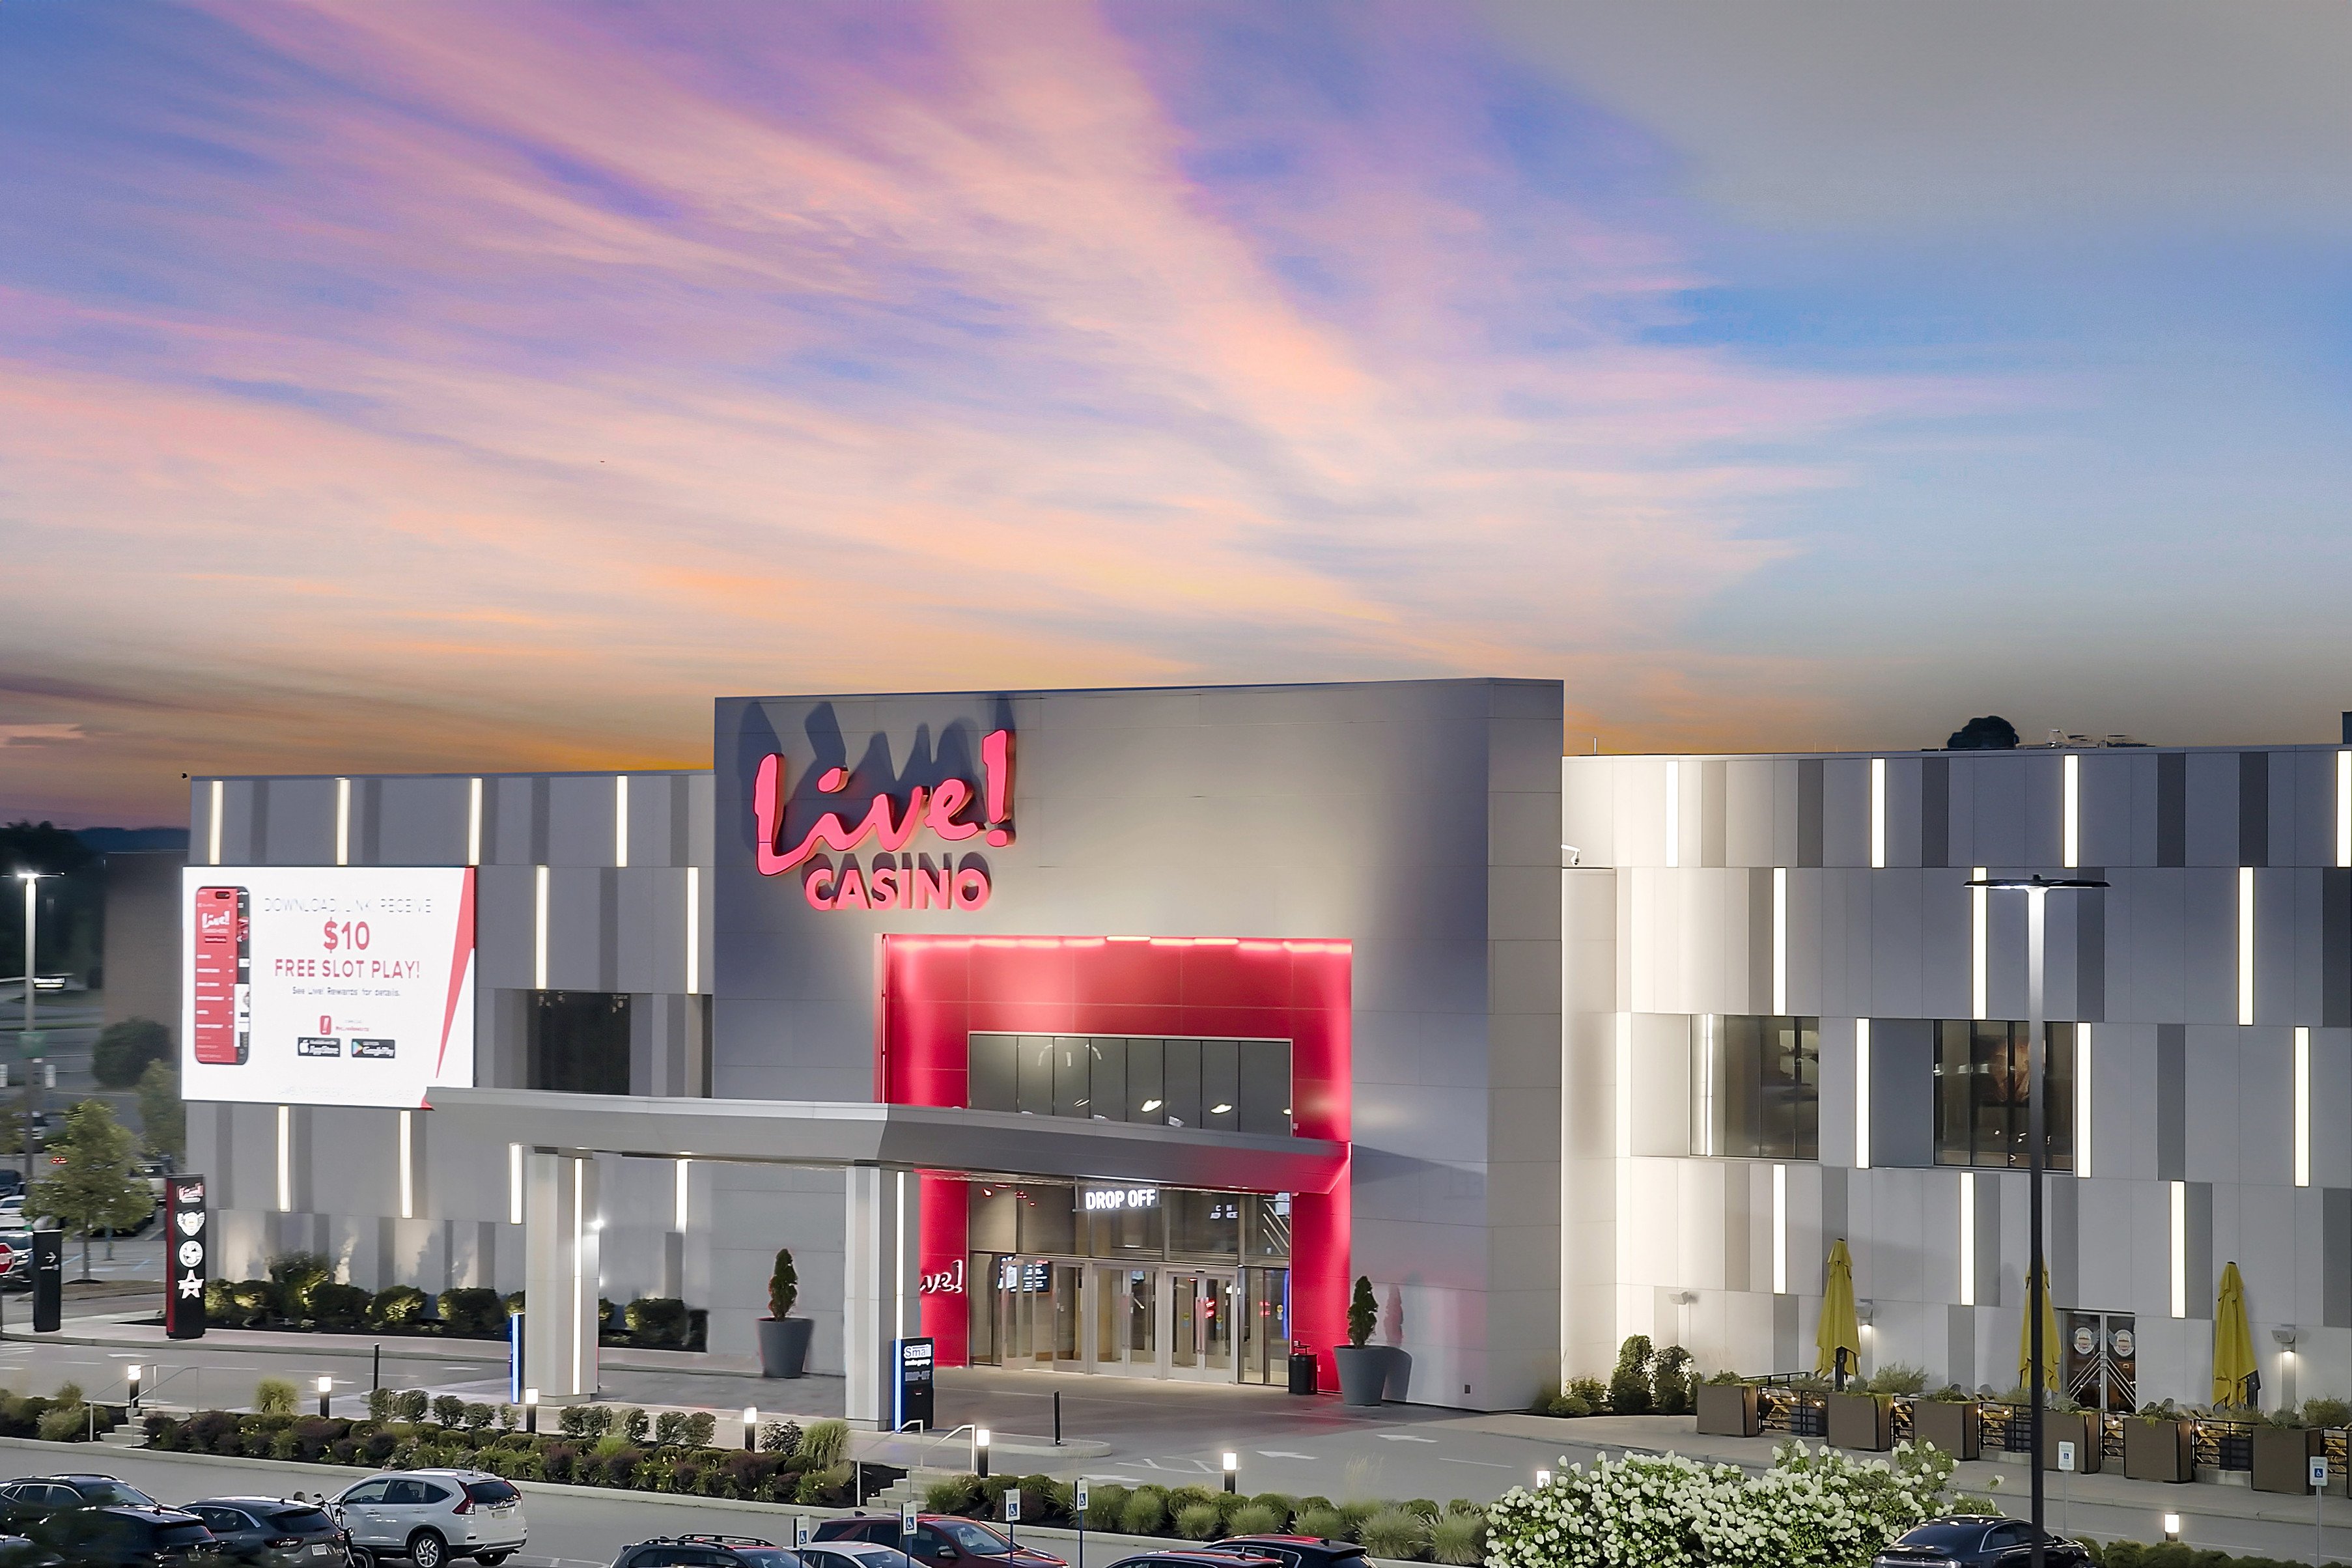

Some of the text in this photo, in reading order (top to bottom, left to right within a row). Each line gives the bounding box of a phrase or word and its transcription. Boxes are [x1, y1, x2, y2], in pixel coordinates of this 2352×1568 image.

[753, 729, 1015, 876] Live!
[805, 868, 990, 912] CASINO
[344, 898, 374, 912] LNK
[379, 898, 432, 913] RECEVE
[323, 917, 371, 953] $10
[275, 959, 420, 979] FREE SLOT PLAY!
[1085, 1188, 1156, 1210] DROP OFF
